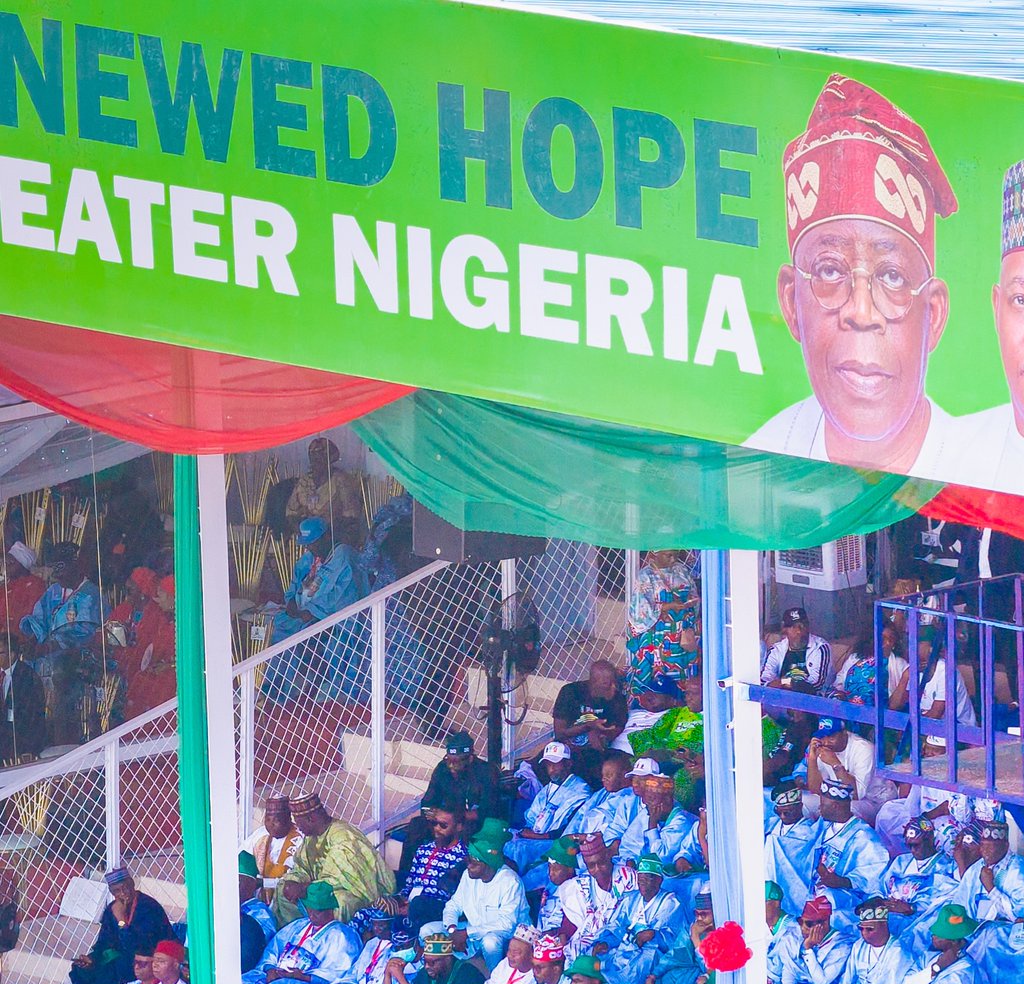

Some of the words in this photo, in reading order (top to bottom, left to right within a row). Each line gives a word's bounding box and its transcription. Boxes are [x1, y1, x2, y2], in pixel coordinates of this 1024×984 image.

[437, 81, 758, 248] HOPE
[0, 155, 299, 296] EATER
[332, 214, 763, 375] NIGERIA
